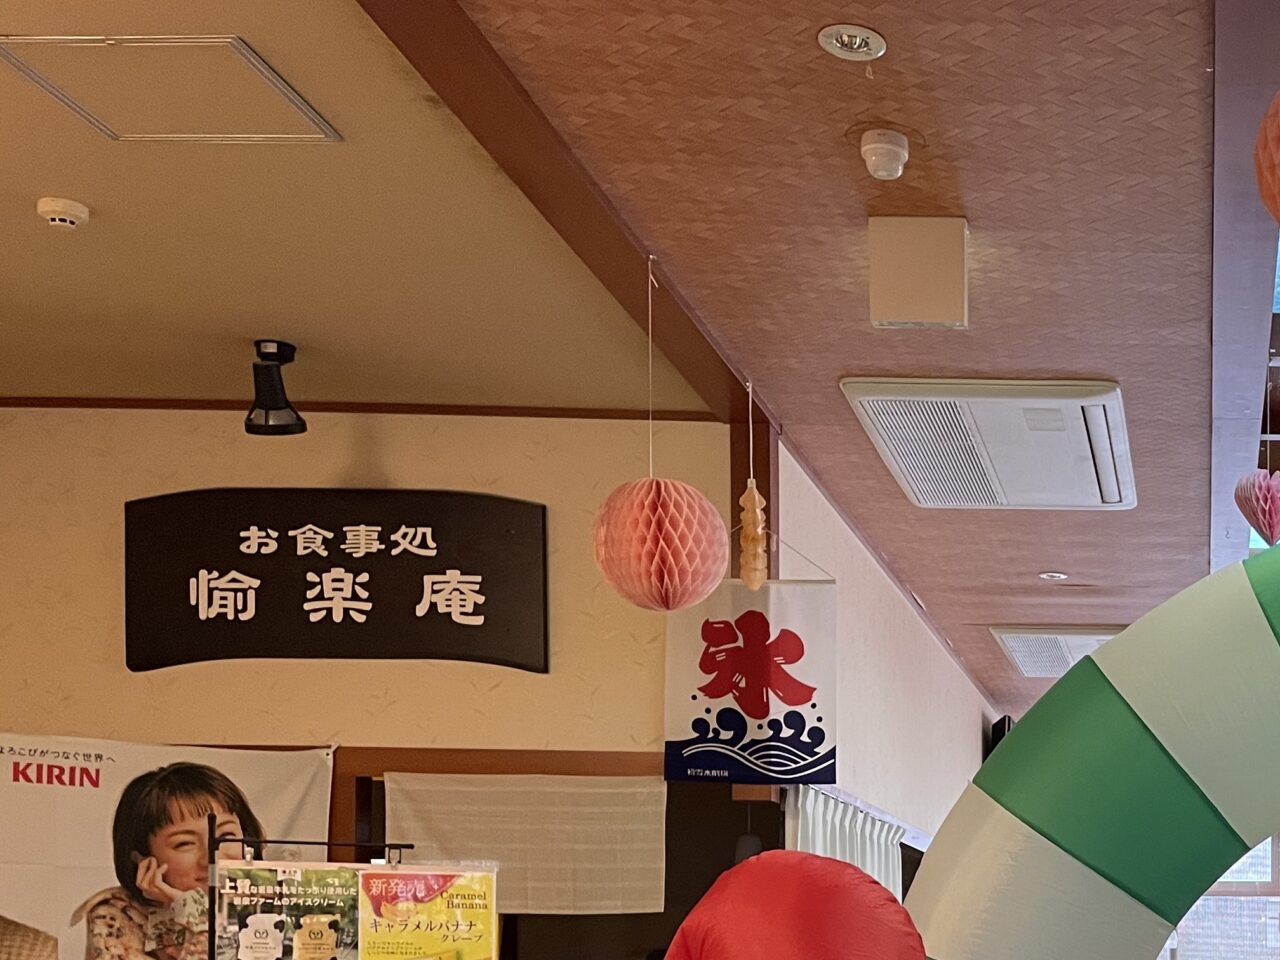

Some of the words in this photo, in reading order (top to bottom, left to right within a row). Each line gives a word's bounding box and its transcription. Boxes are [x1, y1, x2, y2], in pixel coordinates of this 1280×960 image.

[239, 524, 438, 557] お食事処
[190, 567, 486, 625] 愉楽庵
[697, 610, 817, 720] 氷
[13, 761, 100, 788] KIRIN
[369, 878, 425, 898] 新発売
[440, 890, 487, 901] Caramel
[447, 900, 488, 910] Banana
[370, 918, 477, 933] キャラメルバナナ
[441, 934, 483, 943] クレープ
